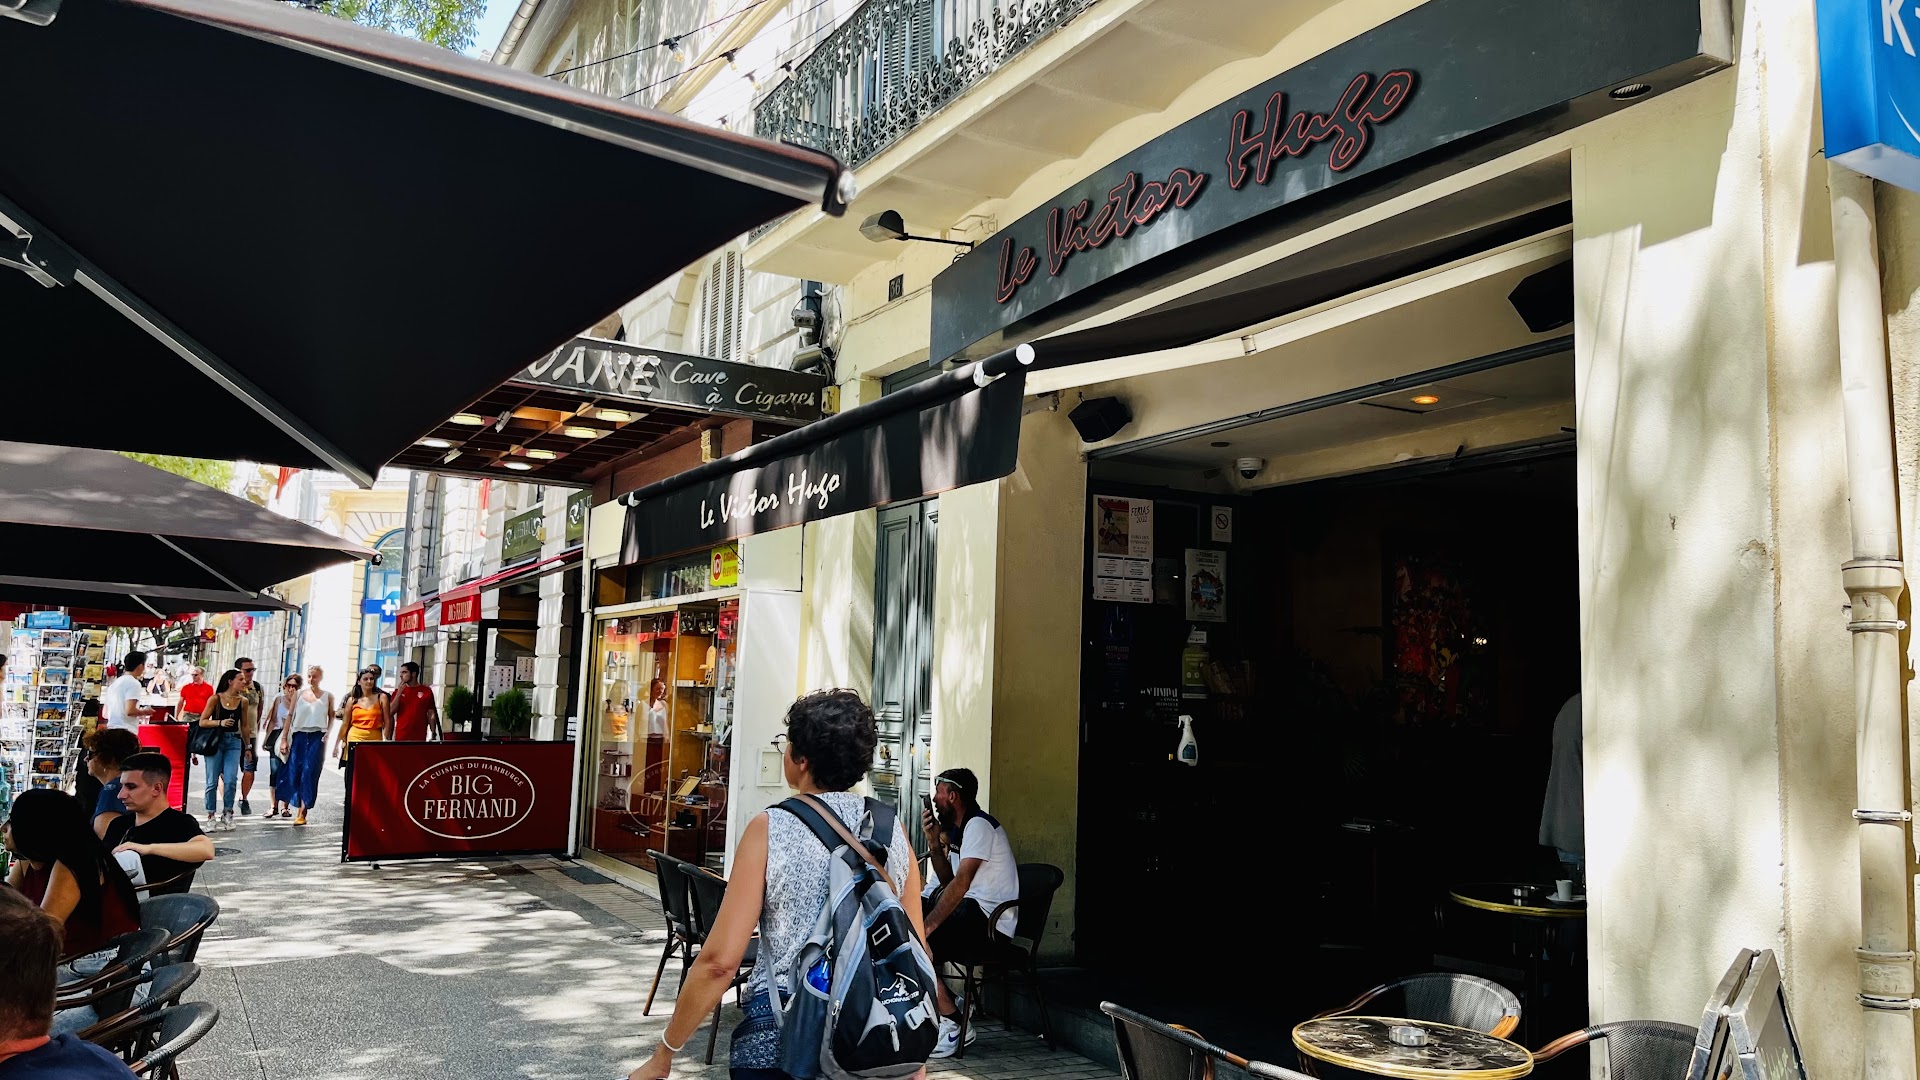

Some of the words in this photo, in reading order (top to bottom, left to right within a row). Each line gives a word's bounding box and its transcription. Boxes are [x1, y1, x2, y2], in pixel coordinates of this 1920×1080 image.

[1881, 0, 1920, 57] K
[996, 237, 1039, 303] Le
[1046, 167, 1208, 277] Victor
[1226, 69, 1417, 190] Hugo
[890, 278, 902, 298] 36
[669, 360, 729, 385] Cave
[705, 386, 723, 405] à
[735, 382, 816, 412] Cigares
[700, 499, 715, 530] Le
[720, 488, 780, 524] Victor
[787, 469, 840, 510] Hugo
[418, 779, 430, 790] LA
[430, 763, 465, 780] CUISINE
[450, 774, 493, 796] BIG
[423, 797, 517, 820] FERNAND
